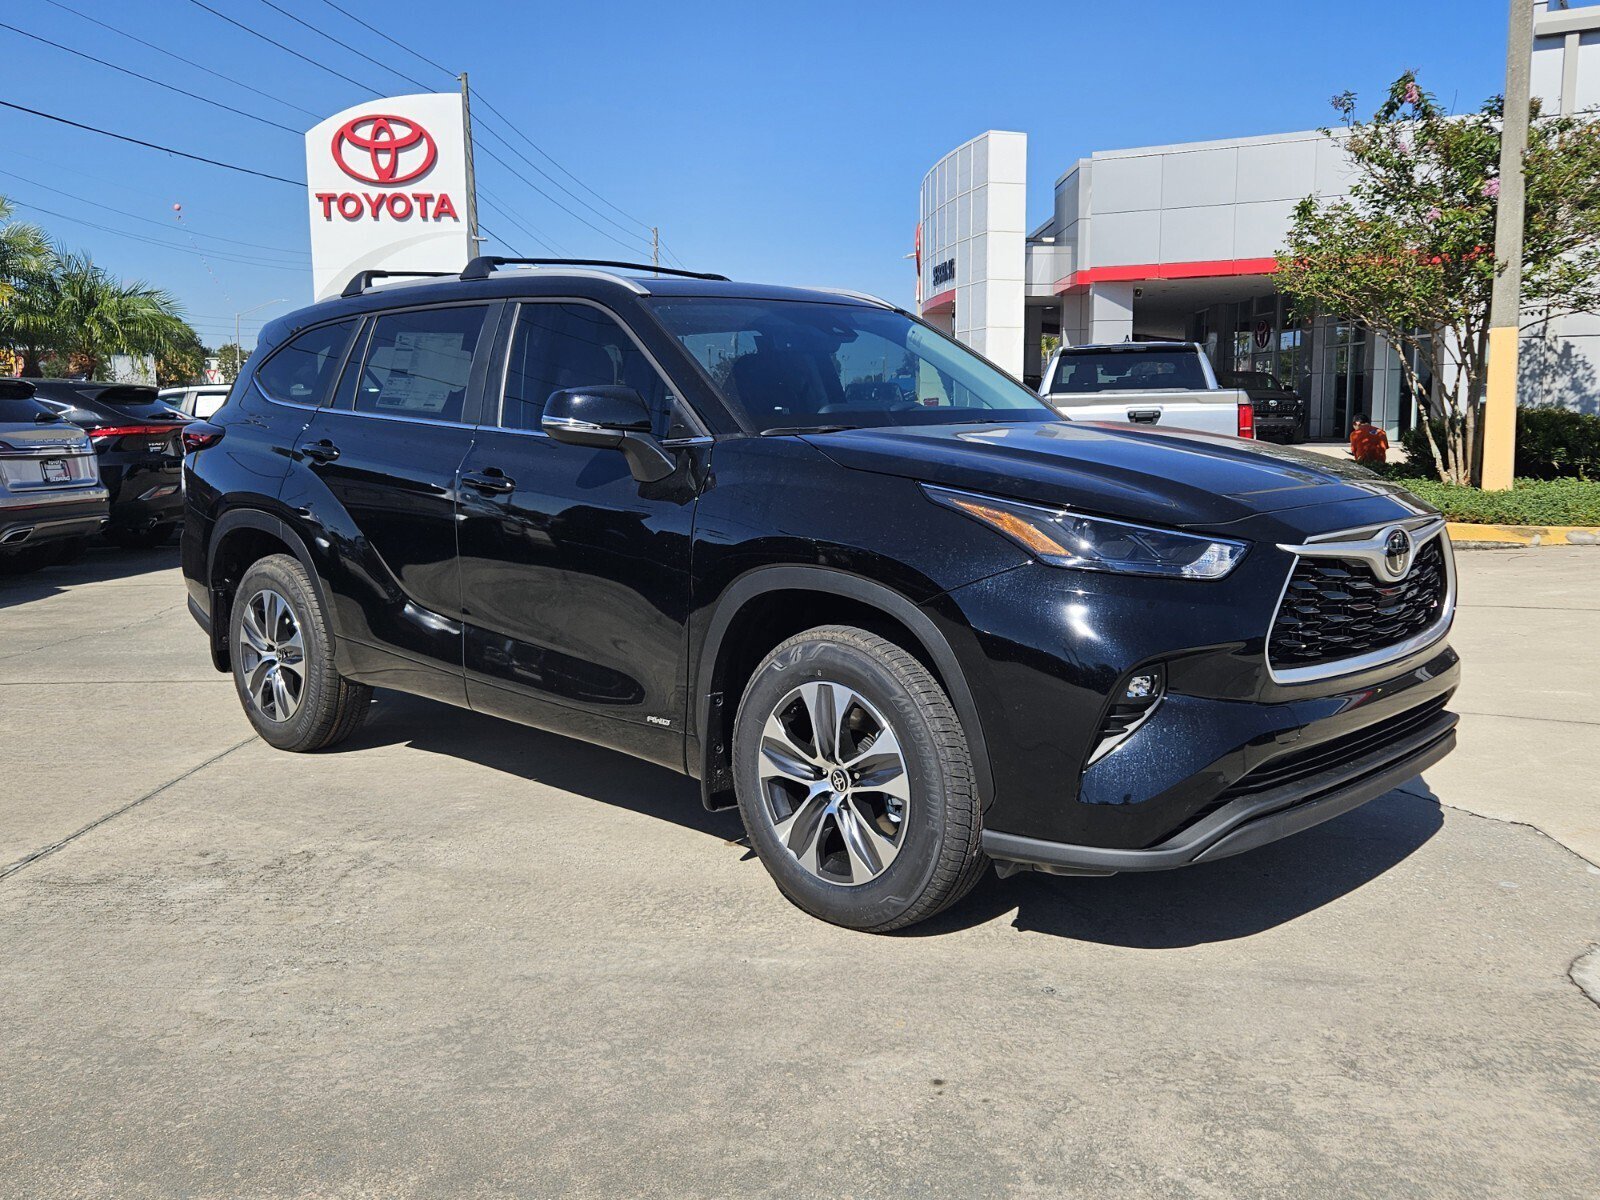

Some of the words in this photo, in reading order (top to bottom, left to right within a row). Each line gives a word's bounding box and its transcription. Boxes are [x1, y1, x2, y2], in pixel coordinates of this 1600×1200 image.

[315, 192, 460, 221] TOYOTA
[646, 715, 672, 726] AWD
[890, 696, 941, 830] BRIDGESTONE
